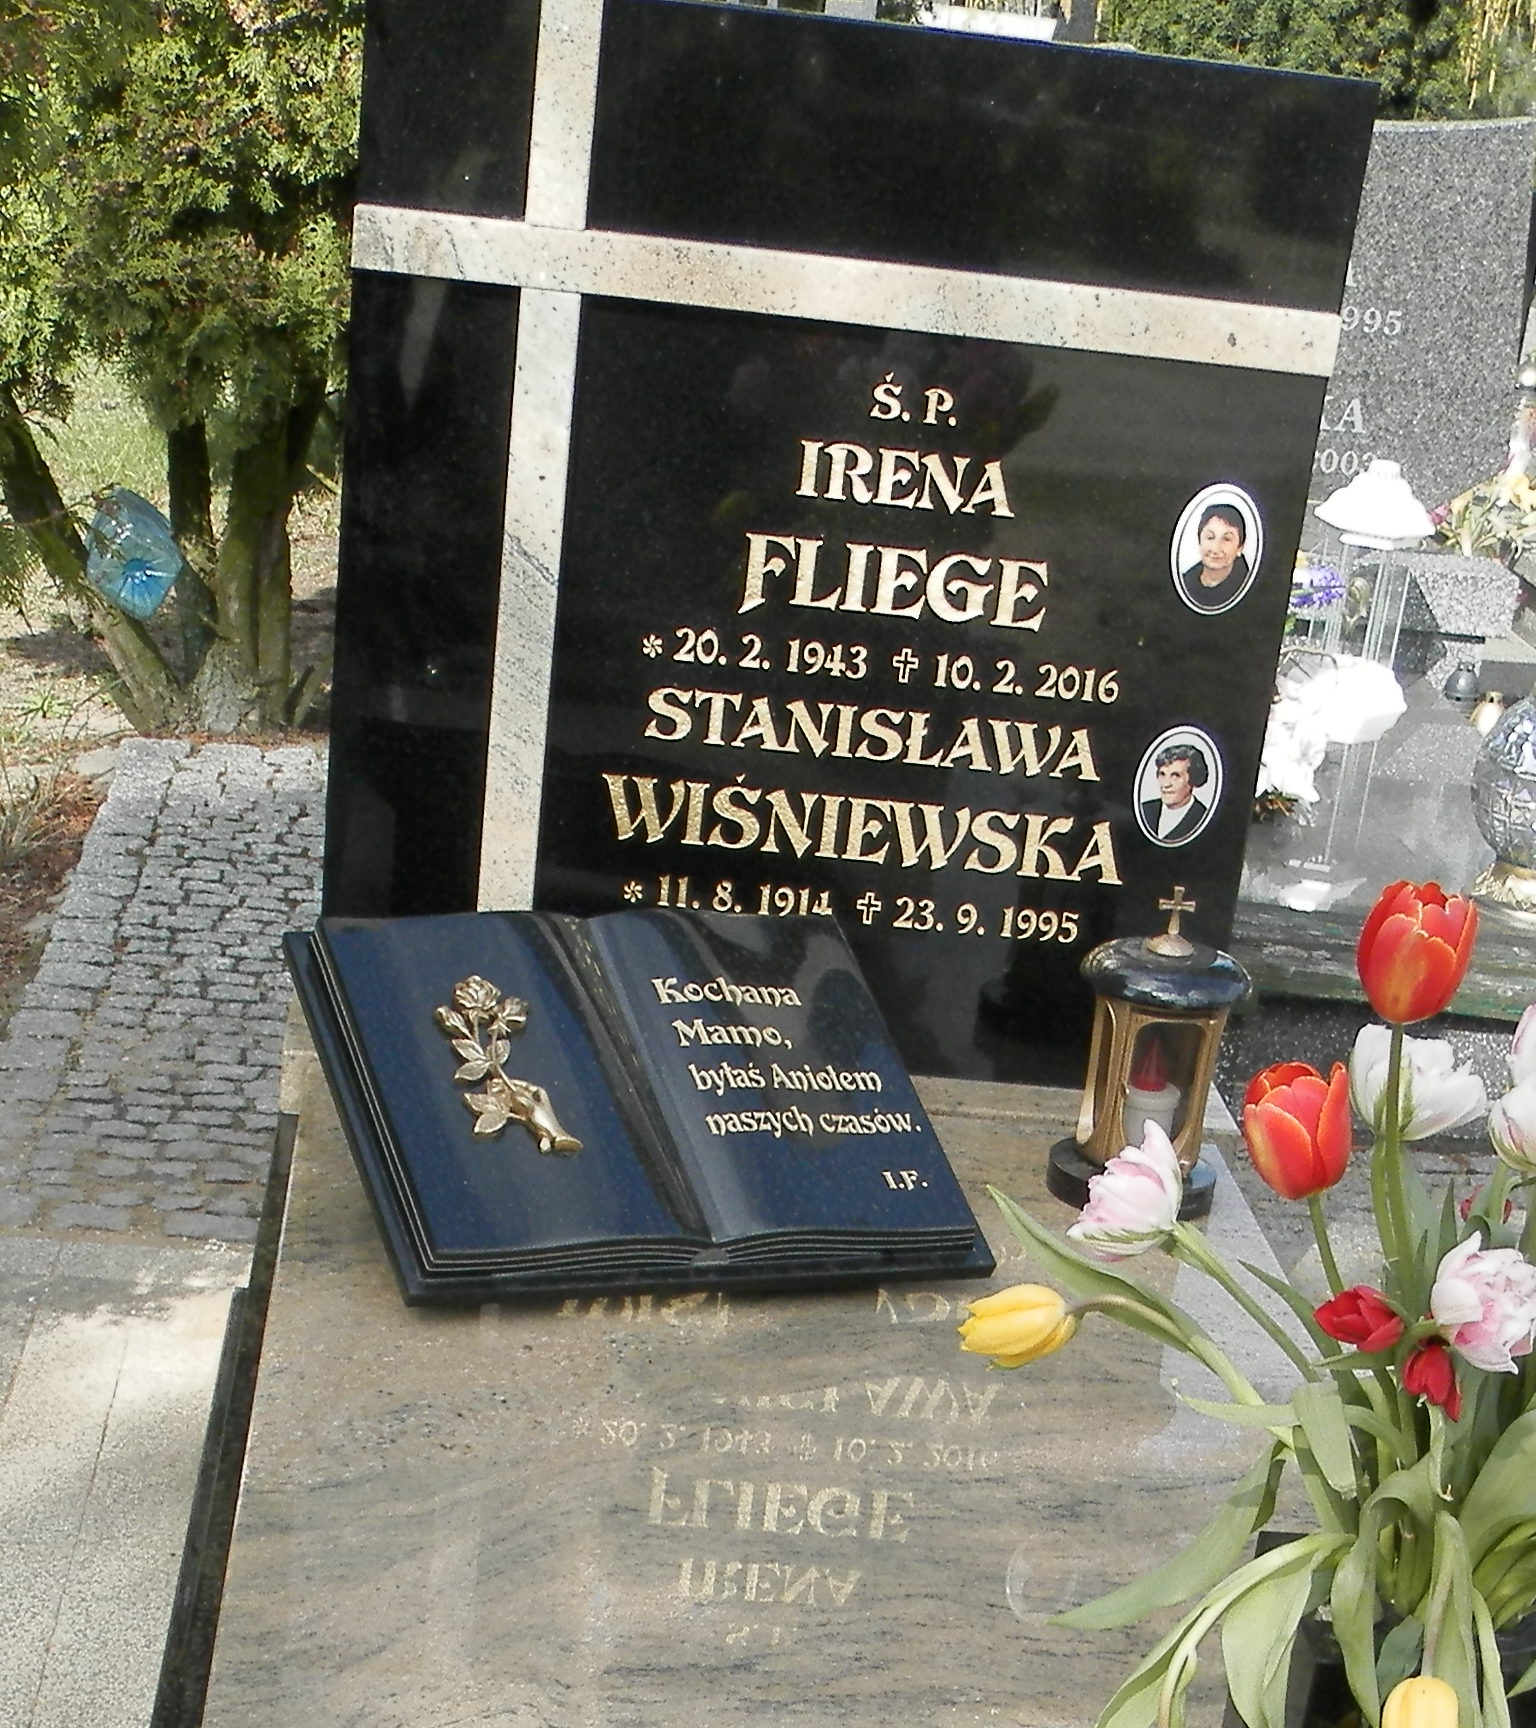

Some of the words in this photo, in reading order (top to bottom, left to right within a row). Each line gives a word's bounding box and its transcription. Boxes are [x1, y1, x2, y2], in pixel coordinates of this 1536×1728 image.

[869, 371, 912, 422] Ś.
[922, 386, 957, 427] P.
[795, 439, 1015, 519] IRENA
[737, 531, 1049, 633] FLIEGE
[674, 627, 727, 666] 20.
[738, 633, 770, 671] 2.
[786, 639, 869, 680] 1943
[933, 653, 981, 692] 10.
[993, 660, 1025, 696] 2.
[1034, 664, 1120, 704] 2016
[644, 687, 1101, 782] STANISŁAWA
[602, 772, 1124, 886] WIŚNIEWSKA
[657, 875, 700, 910] 11.
[711, 881, 743, 914] 8.
[757, 883, 833, 918] 1914
[892, 896, 945, 934] 23.
[956, 904, 985, 937] 9.
[1000, 906, 1080, 945] 1995
[650, 976, 802, 1006] Kochana
[671, 1018, 793, 1049] Mamo,
[688, 1061, 766, 1096] byłaś
[769, 1063, 882, 1092] Aniołem
[704, 1105, 814, 1138] naszych
[819, 1107, 922, 1135] czasów.
